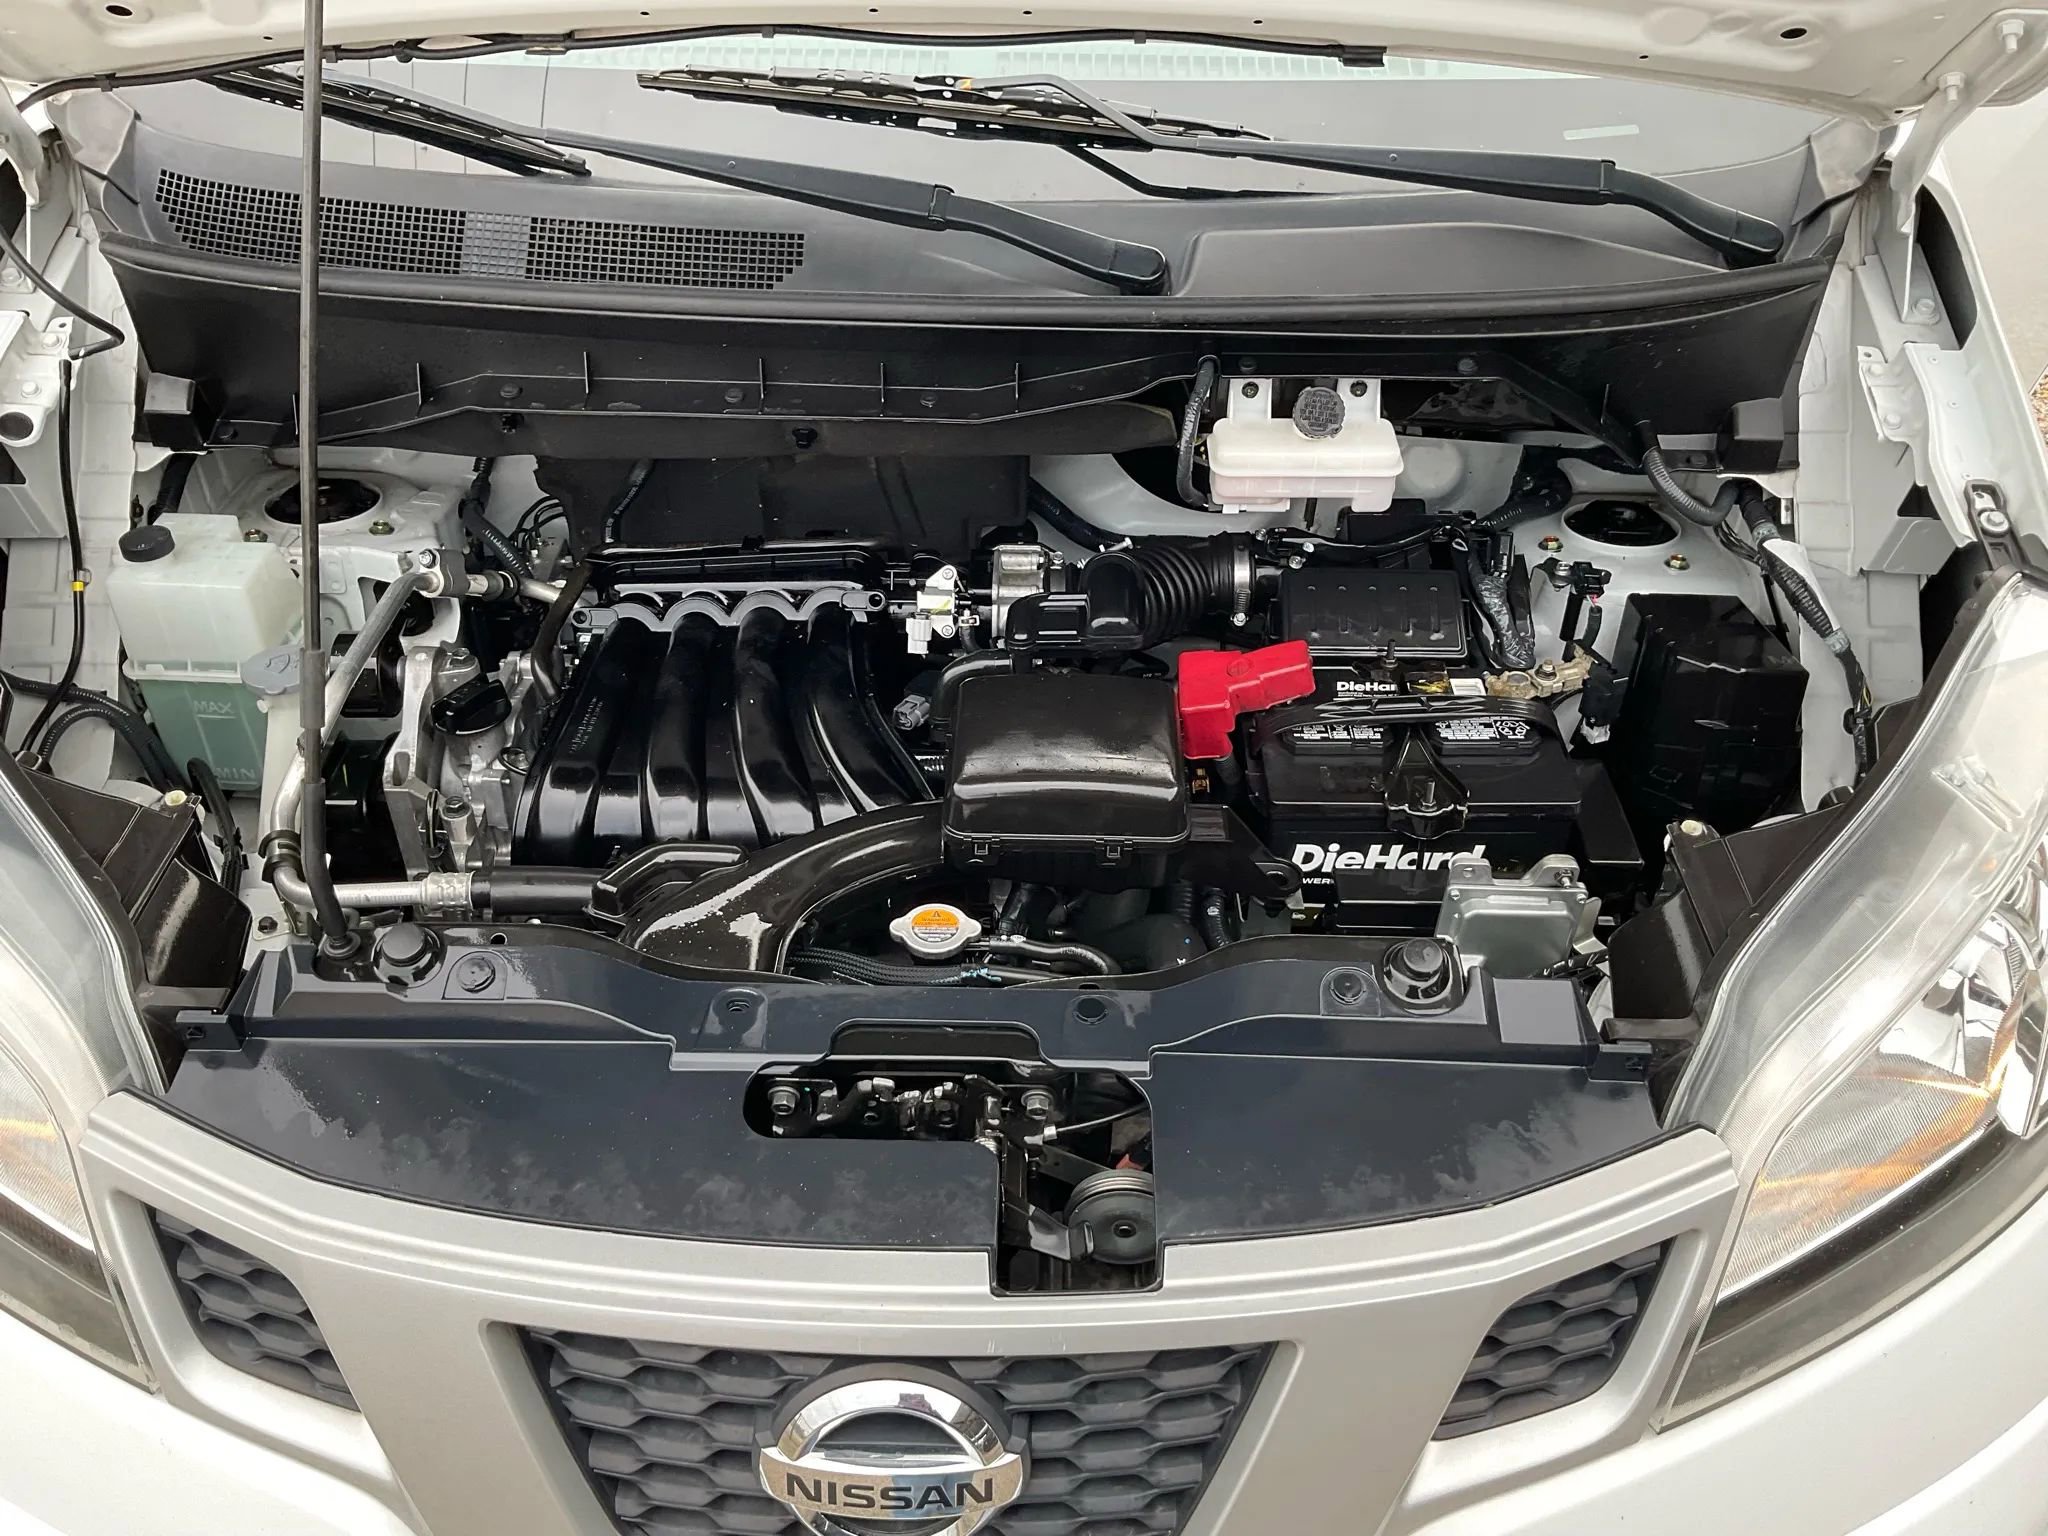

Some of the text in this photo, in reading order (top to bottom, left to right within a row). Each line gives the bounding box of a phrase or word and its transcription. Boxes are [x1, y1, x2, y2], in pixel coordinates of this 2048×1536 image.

[1336, 681, 1398, 691] DieHar
[193, 701, 235, 713] MAX
[215, 767, 256, 779] MIN
[1302, 877, 1331, 885] WER
[786, 1472, 994, 1510] NISSAN
